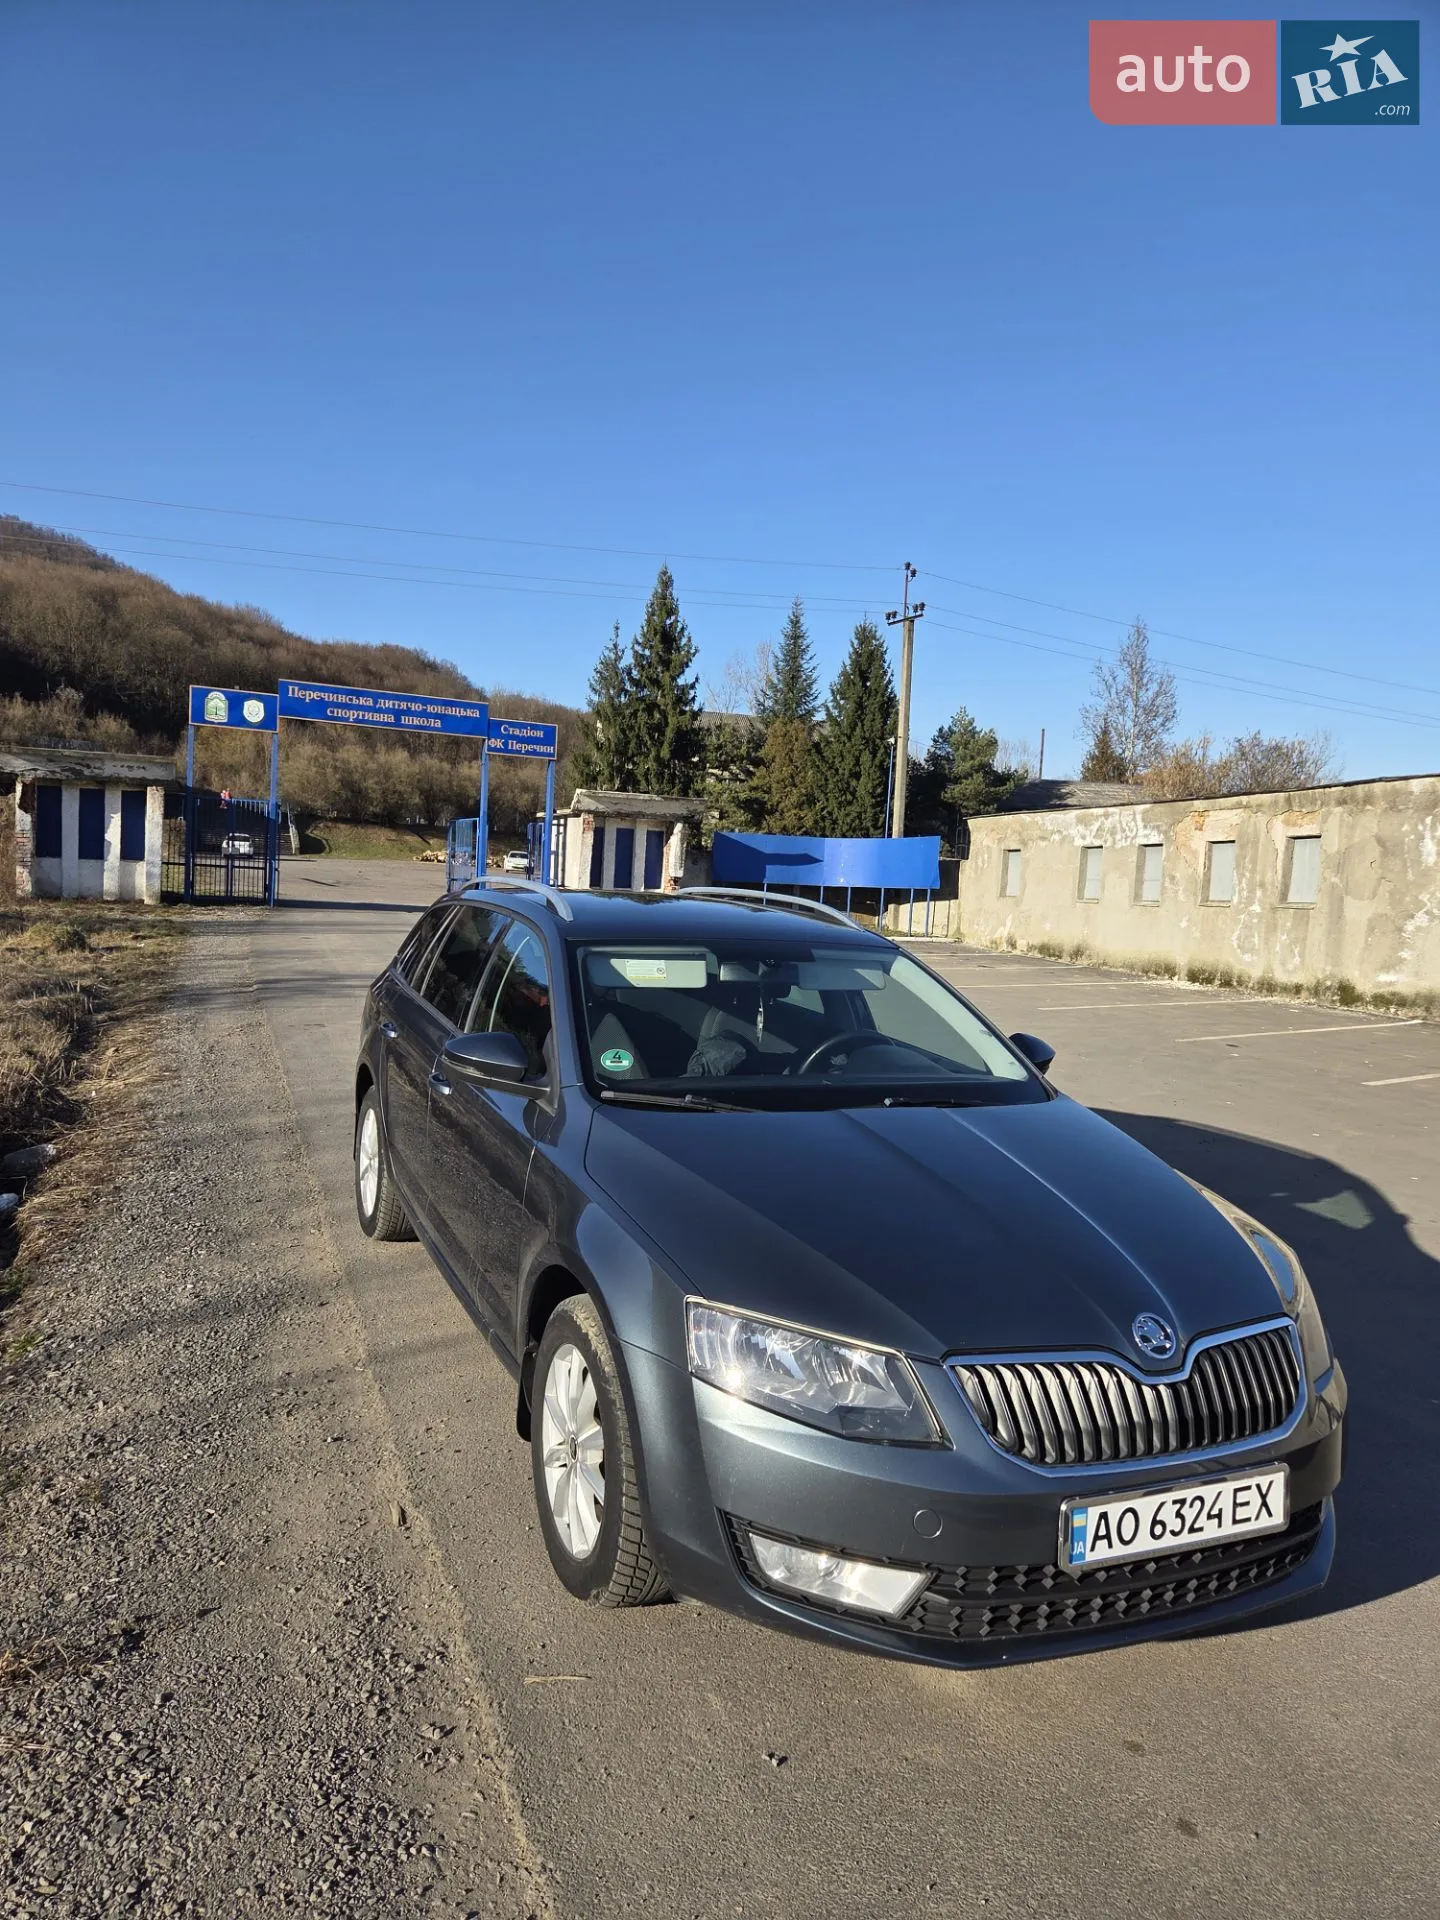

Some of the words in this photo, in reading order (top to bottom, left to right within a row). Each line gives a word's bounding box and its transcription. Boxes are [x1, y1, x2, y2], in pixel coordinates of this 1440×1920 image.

[287, 685, 374, 707] Перечинська
[376, 698, 480, 718] дитячо-юнацька
[326, 707, 395, 723] спортивна
[401, 715, 441, 728] школа
[501, 724, 544, 738] Стадіон
[488, 738, 505, 749] ФК
[508, 740, 554, 753] Перечин
[613, 1051, 621, 1060] 4
[1089, 1507, 1140, 1553] AO
[1149, 1491, 1223, 1540] 6324
[1231, 1479, 1274, 1526] EX
